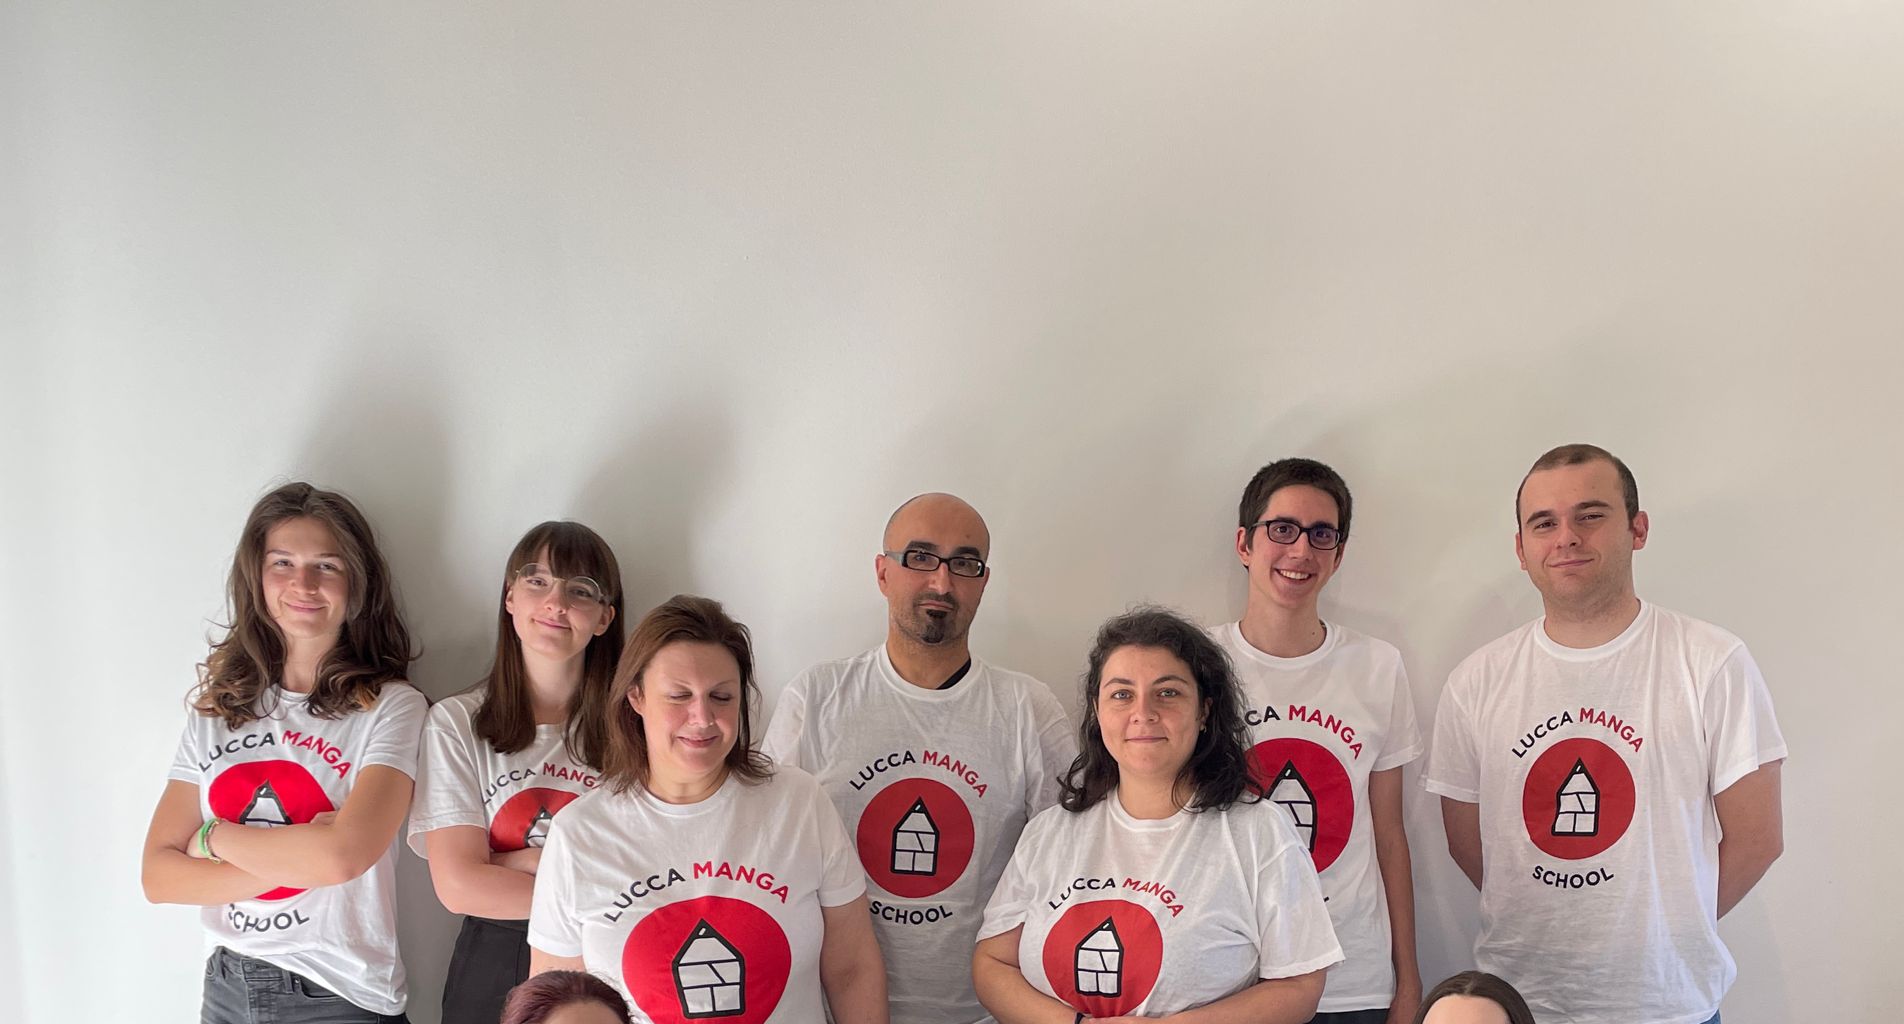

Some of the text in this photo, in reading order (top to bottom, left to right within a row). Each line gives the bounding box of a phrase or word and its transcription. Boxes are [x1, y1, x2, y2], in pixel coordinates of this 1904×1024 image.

[199, 730, 352, 780] LUCCA MANGA
[1287, 704, 1363, 760] MANGA
[1511, 707, 1643, 758] LUCCA MANGA
[542, 762, 600, 789] MANG
[849, 750, 988, 797] LUCCA MANGA
[604, 861, 790, 922] LUCCA MANGA
[1049, 877, 1185, 918] LUCCA MANGA
[1532, 865, 1615, 889] SCHOOL
[870, 900, 953, 925] SCHOOL
